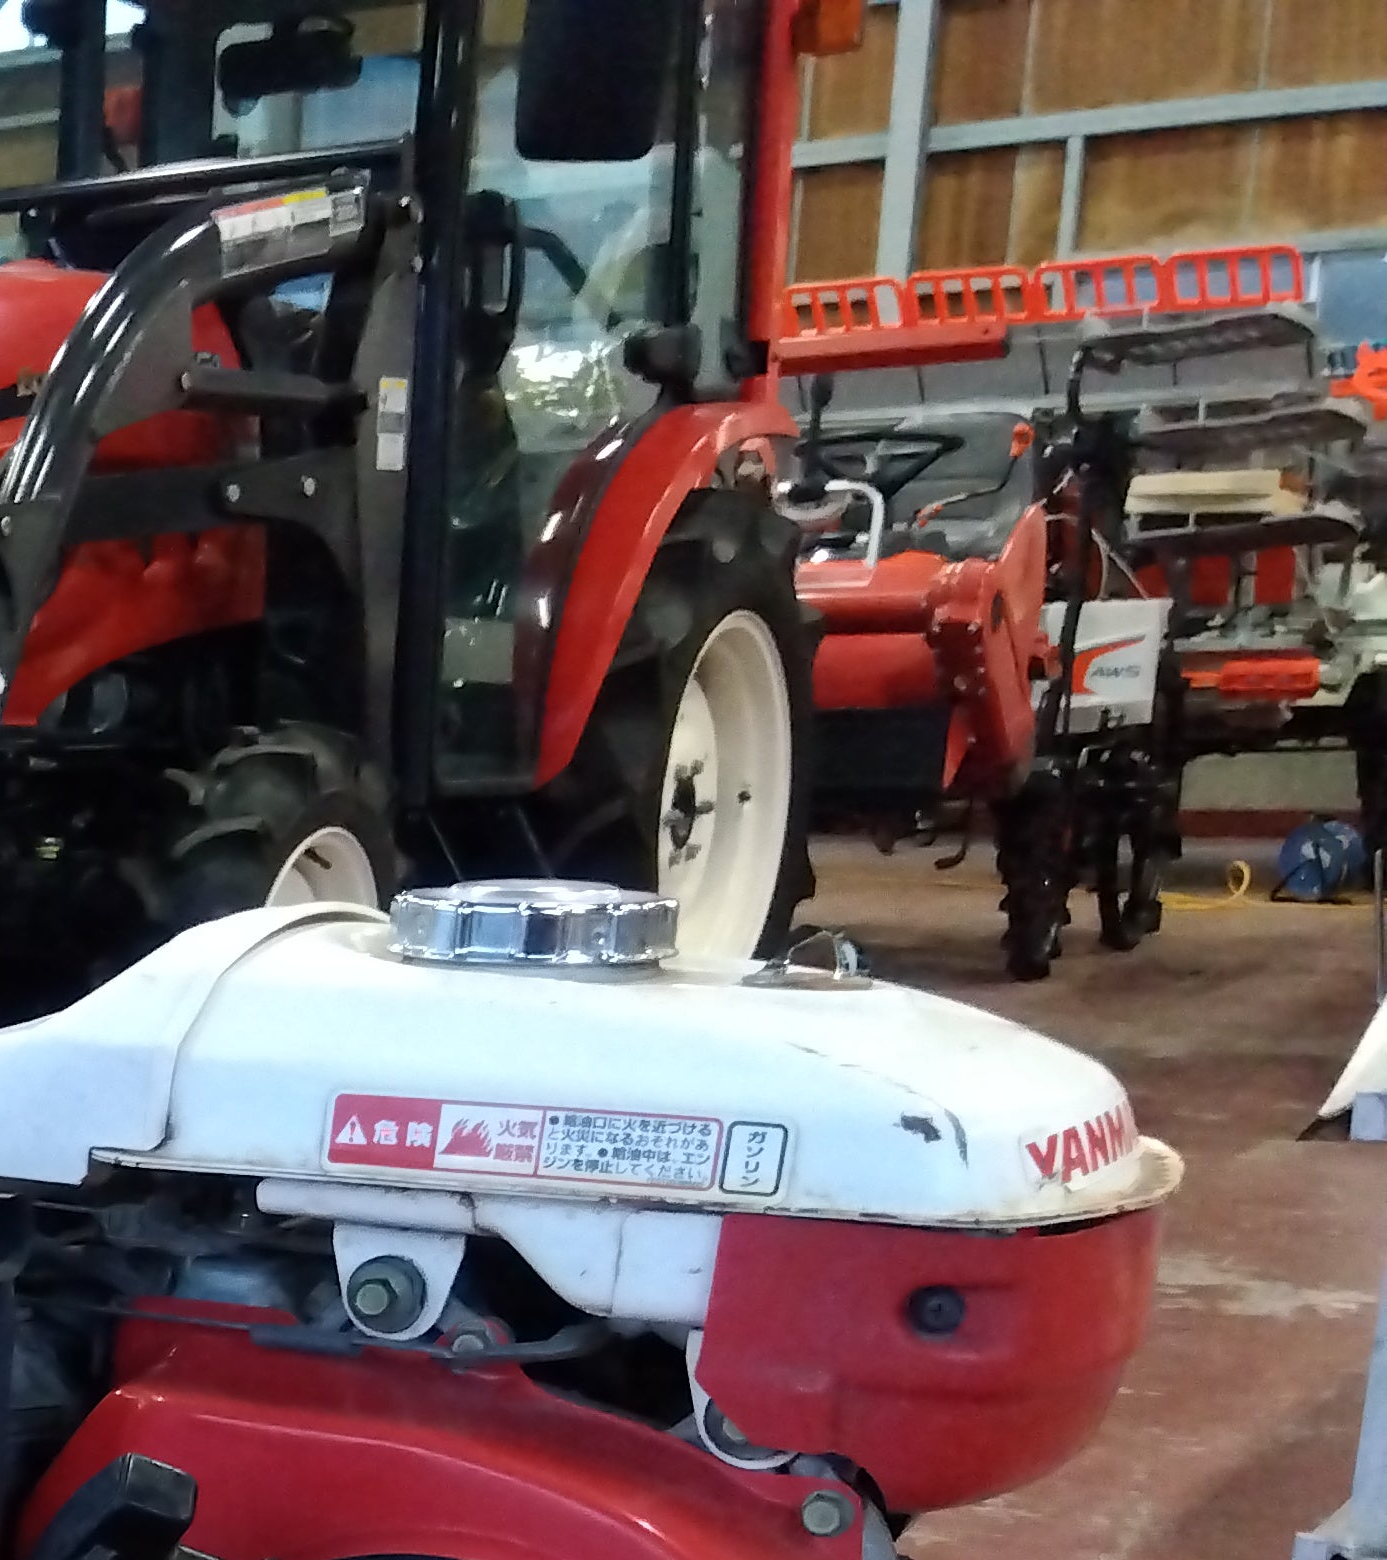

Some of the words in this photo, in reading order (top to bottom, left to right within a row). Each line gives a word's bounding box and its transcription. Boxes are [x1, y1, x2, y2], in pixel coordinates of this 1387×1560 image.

[373, 1119, 433, 1148] 危険
[497, 1119, 537, 1141] 火気
[740, 1131, 768, 1188] ガソリン
